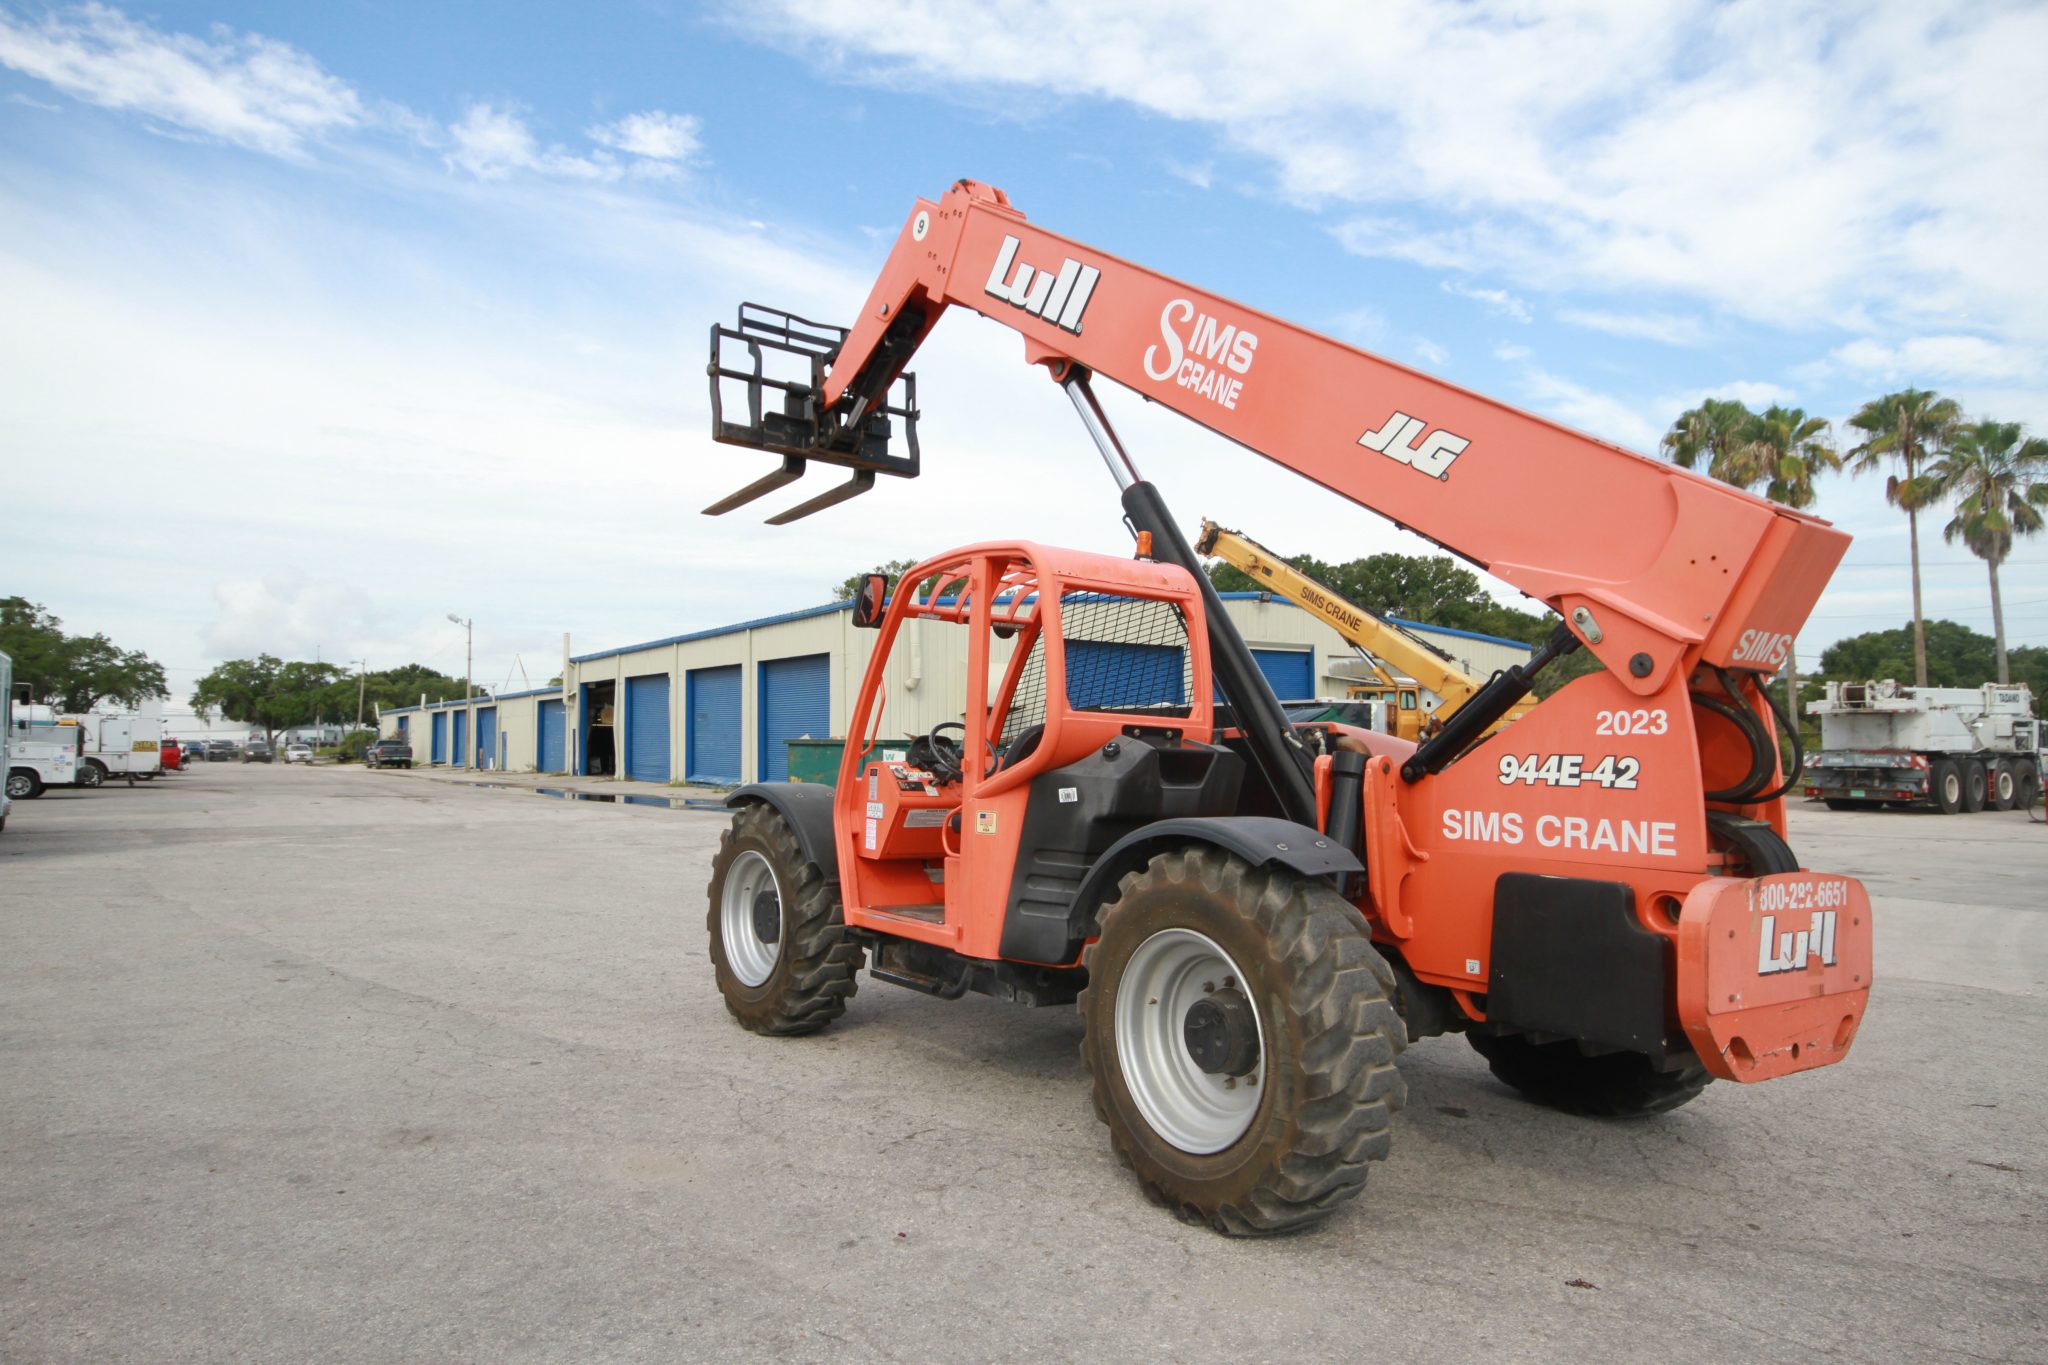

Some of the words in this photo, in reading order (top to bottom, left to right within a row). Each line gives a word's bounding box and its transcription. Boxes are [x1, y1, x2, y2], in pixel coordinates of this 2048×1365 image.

[918, 219, 925, 234] 9
[984, 233, 1102, 337] Lull
[1143, 298, 1258, 381] SIMS
[1176, 358, 1244, 410] CRANE
[1356, 410, 1473, 480] JLG
[1300, 586, 1325, 609] SIMS
[1325, 601, 1363, 632] CRANE
[1732, 628, 1793, 665] SIMS
[1596, 709, 1668, 736] 2023
[1498, 754, 1640, 790] 944E-42
[1442, 809, 1524, 845] SIMS
[1535, 815, 1677, 856] CRANE
[1757, 909, 1838, 977] Lull
